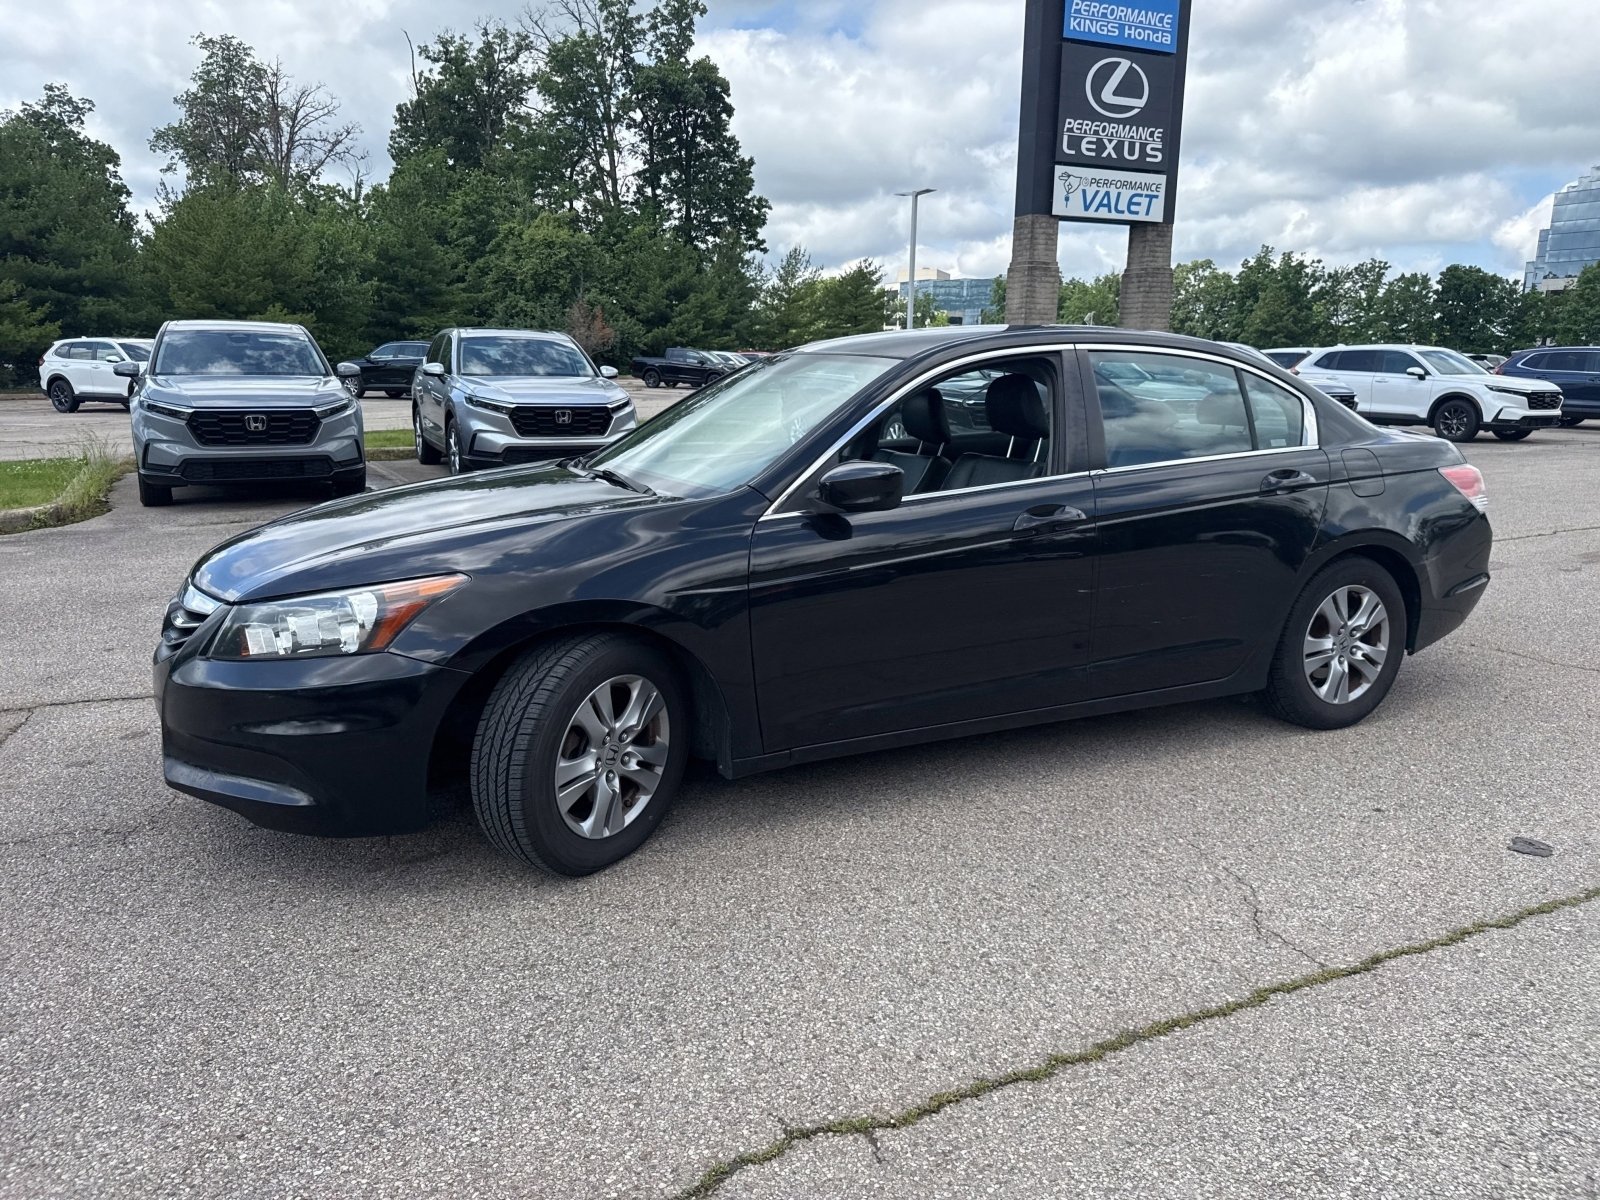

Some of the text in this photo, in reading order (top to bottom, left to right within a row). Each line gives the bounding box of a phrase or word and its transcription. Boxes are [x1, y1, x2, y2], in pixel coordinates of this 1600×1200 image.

[1071, 0, 1173, 28] PERFORMANCE
[1070, 17, 1171, 44] KINGS Honda
[1063, 118, 1163, 141] PERFORMANCE
[1062, 134, 1162, 162] LEXUS
[1089, 177, 1162, 192] PERFORMANCE
[1081, 188, 1159, 216] VALET
